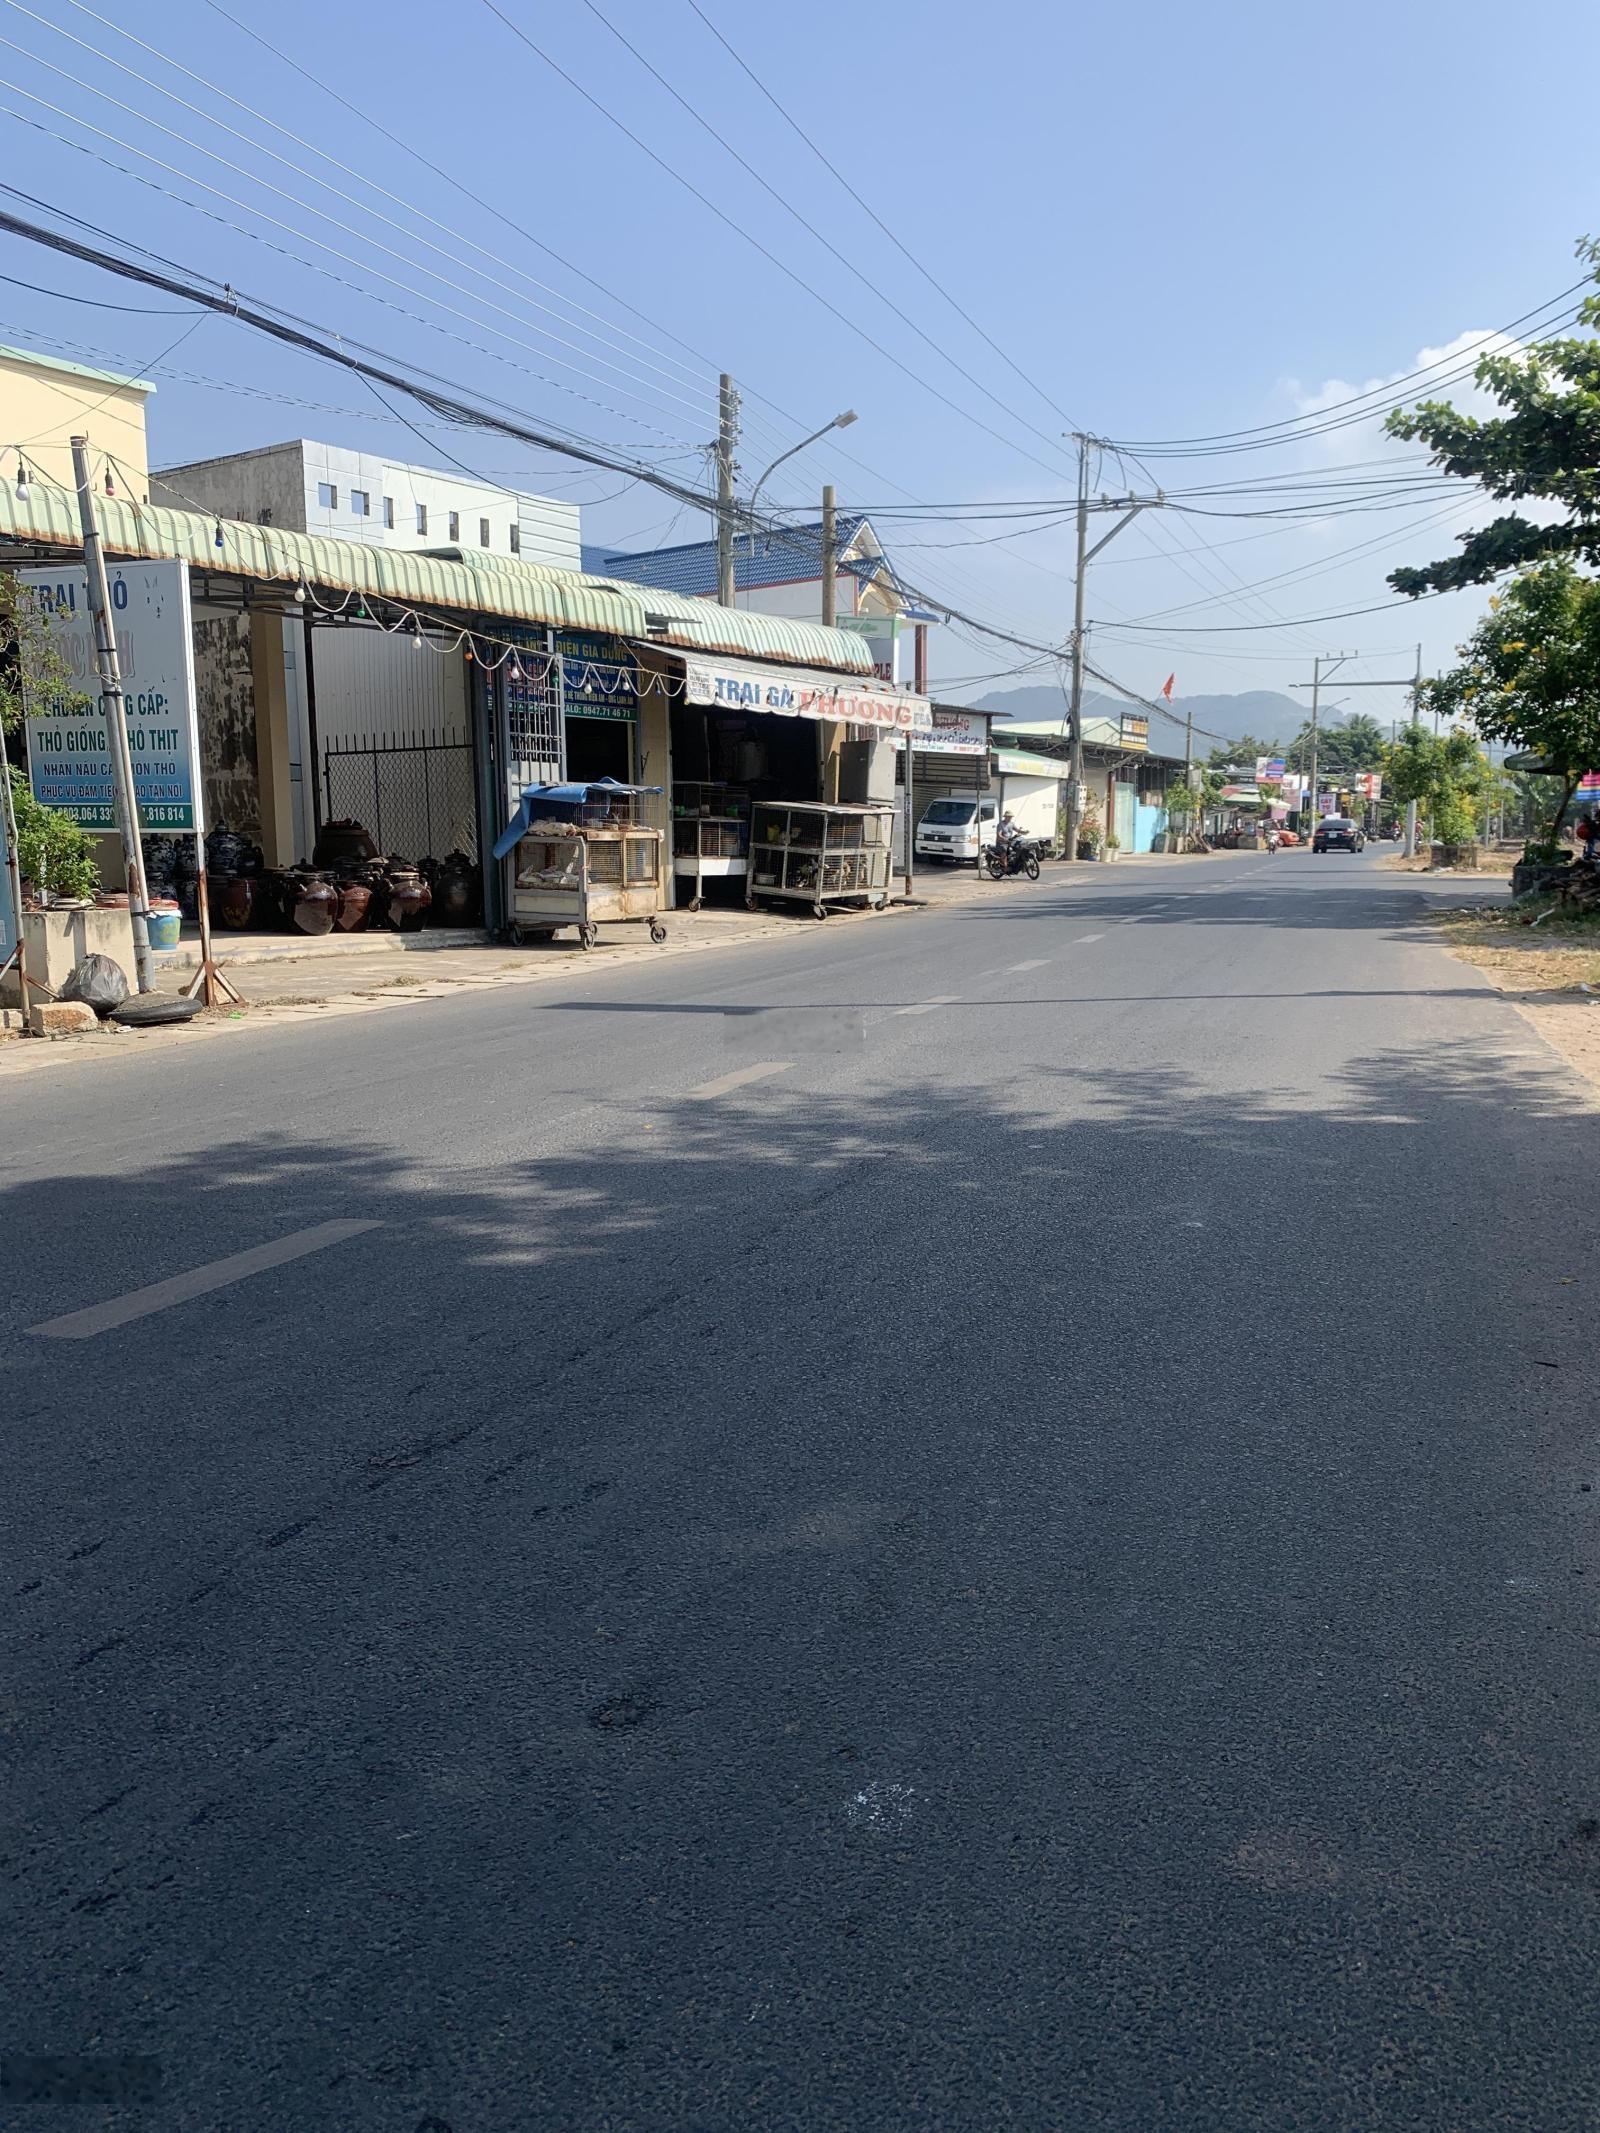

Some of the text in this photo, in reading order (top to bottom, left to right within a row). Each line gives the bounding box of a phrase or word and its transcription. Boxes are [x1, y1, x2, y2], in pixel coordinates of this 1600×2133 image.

[582, 644, 599, 658] GIA
[138, 686, 169, 716] CẤP:
[767, 684, 796, 709] GÀ
[37, 724, 63, 752] THỎ
[149, 729, 178, 755] THỊT
[167, 806, 185, 821] 814
